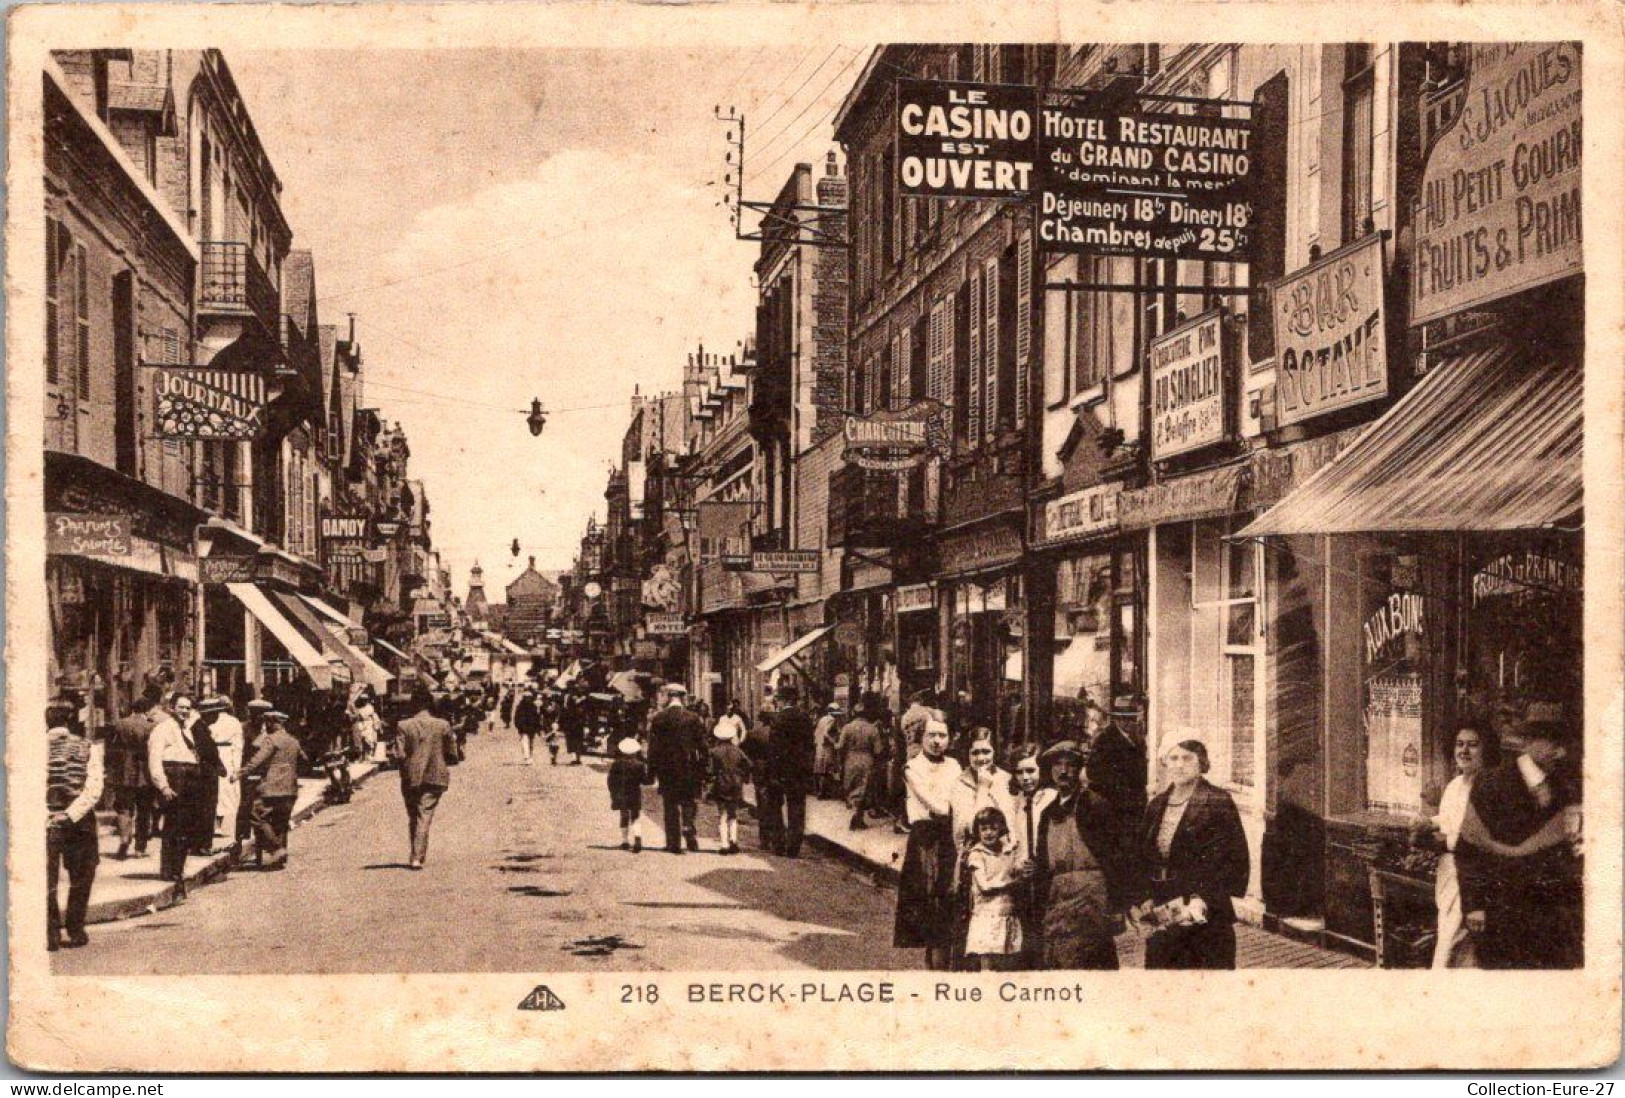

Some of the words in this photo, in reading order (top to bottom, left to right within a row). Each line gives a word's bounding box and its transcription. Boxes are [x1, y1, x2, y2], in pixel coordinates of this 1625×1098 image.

[949, 89, 989, 105] LE
[1477, 40, 1572, 142] JACQUES
[901, 103, 1032, 142] CASINO
[1043, 110, 1107, 142] HOTEL
[1119, 116, 1251, 150] RESTAURANT
[941, 143, 990, 155] EST
[1050, 147, 1072, 163] du
[1080, 141, 1154, 170] GRAND
[1164, 147, 1250, 176] CASINO
[901, 156, 1034, 192] OUVERT
[1167, 173, 1181, 188] la
[1042, 192, 1129, 222] Déjeuners
[1170, 201, 1223, 228] Diners
[1426, 178, 1446, 233] AU
[1453, 159, 1506, 221] PETIT
[1040, 219, 1151, 250] Chambres
[1154, 228, 1197, 253] depuis
[1417, 226, 1490, 300] FRUITS
[1495, 228, 1512, 271] &
[1287, 261, 1359, 337] BAR
[155, 371, 262, 427] JOURNAUX
[1364, 606, 1390, 664] AUX
